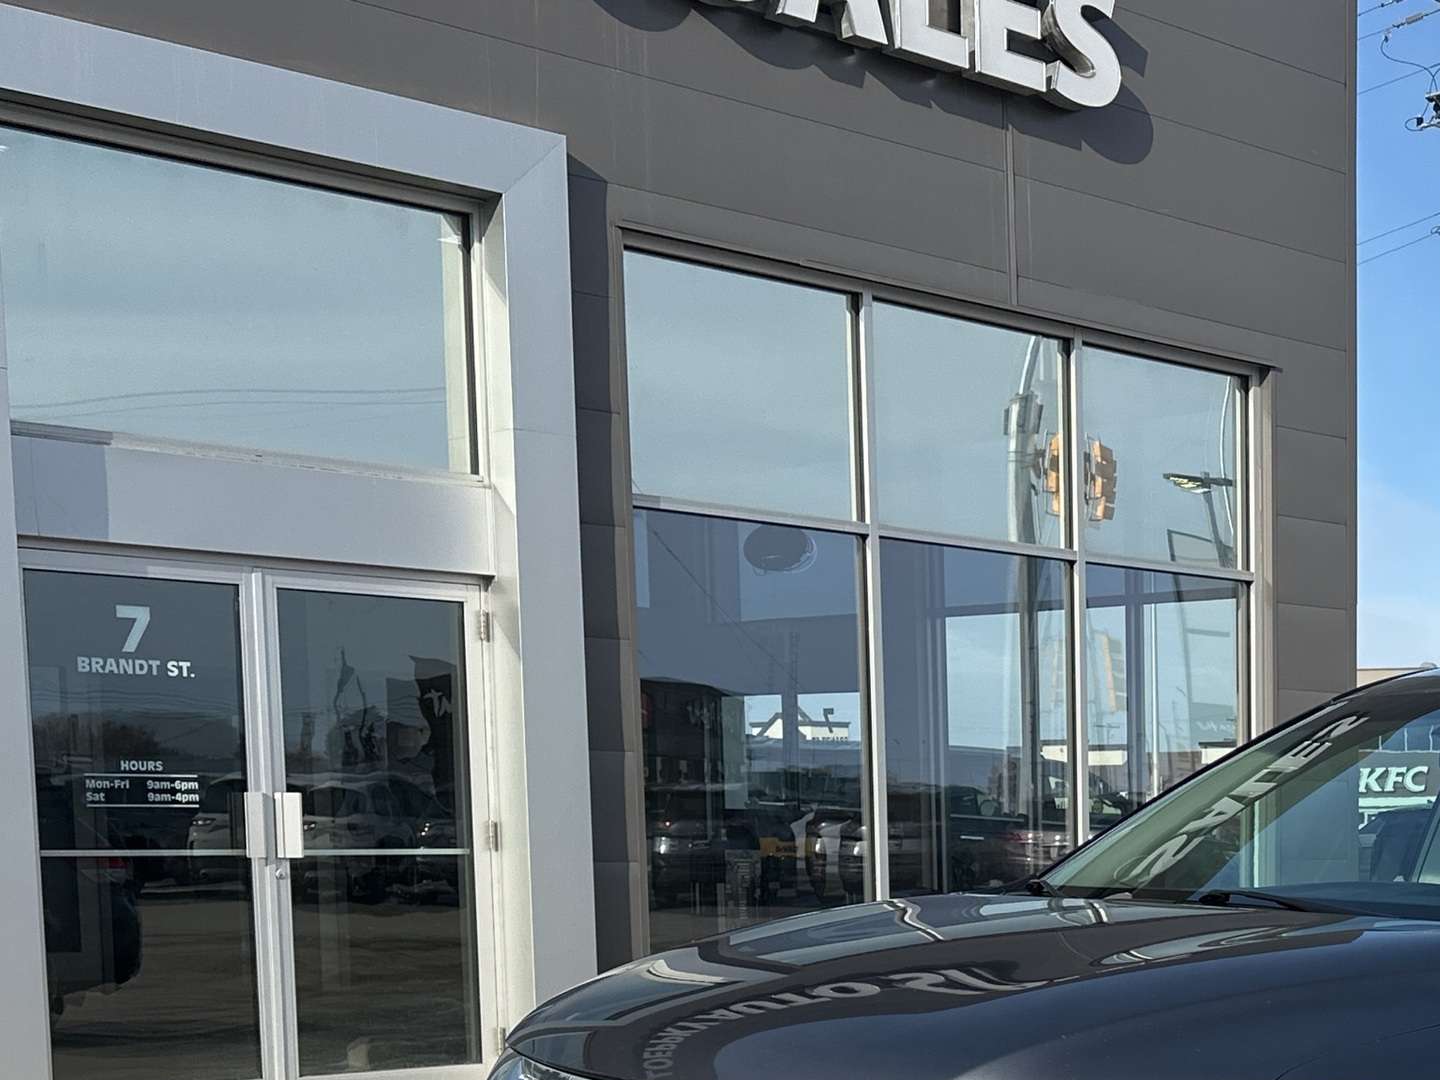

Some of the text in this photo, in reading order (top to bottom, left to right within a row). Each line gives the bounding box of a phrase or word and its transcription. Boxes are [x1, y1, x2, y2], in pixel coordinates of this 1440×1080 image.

[115, 604, 151, 652] 7
[77, 656, 196, 678] BRANDT ST.
[120, 760, 164, 771] HOURS
[85, 779, 199, 791] Mon-Fri 9am-6pm
[1358, 766, 1429, 793] KFC
[86, 792, 200, 803] Sat 9am-4pm
